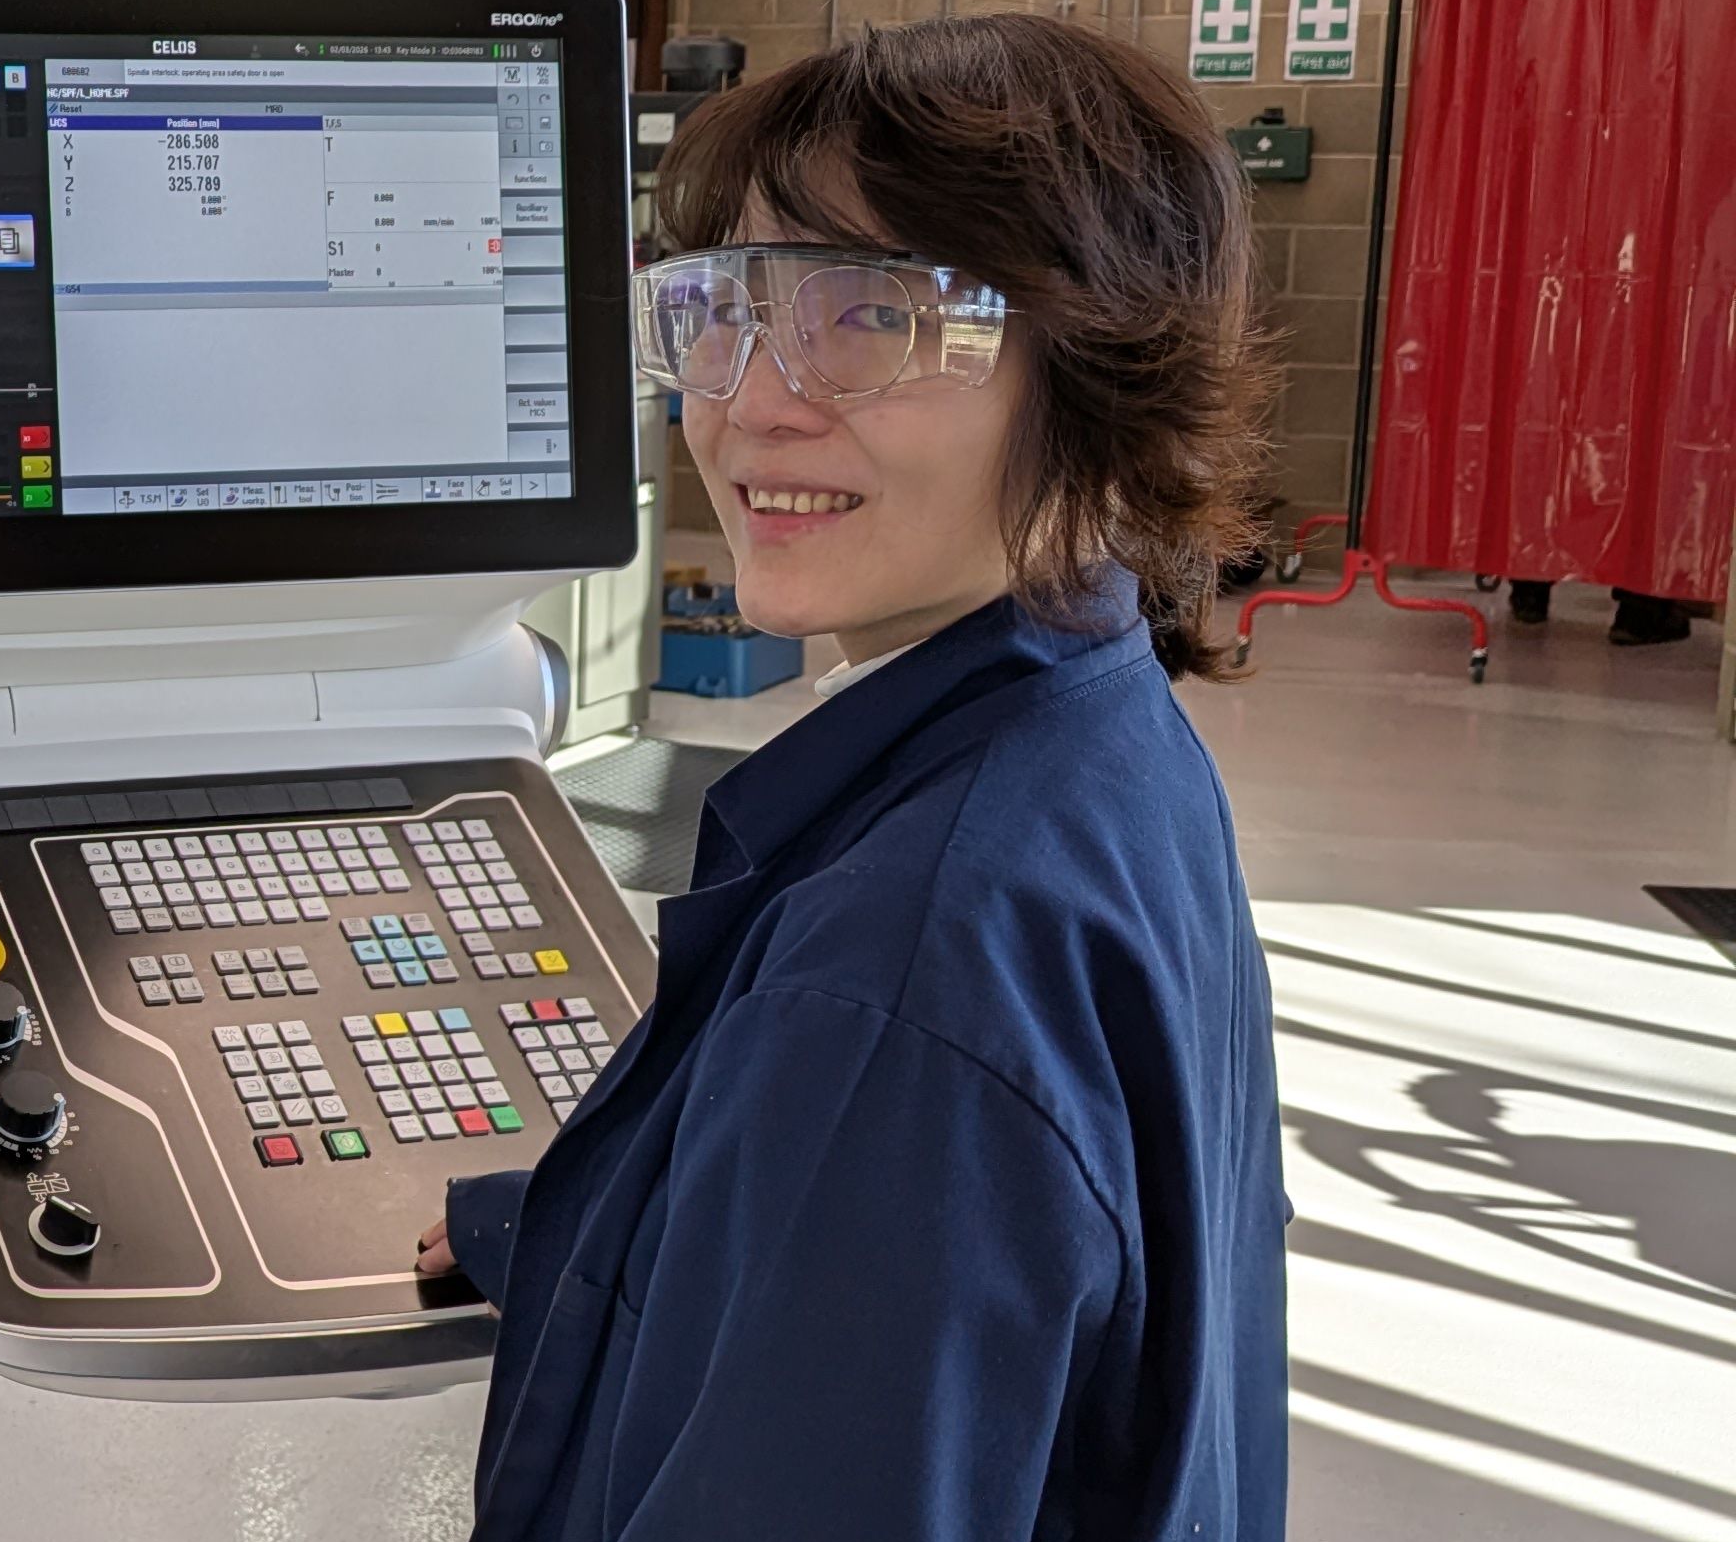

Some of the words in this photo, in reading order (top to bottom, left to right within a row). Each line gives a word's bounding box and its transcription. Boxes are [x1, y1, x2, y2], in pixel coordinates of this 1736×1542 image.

[153, 41, 196, 54] CELOS
[396, 46, 409, 55] Key
[410, 46, 430, 54] Mode
[1196, 59, 1226, 71] First
[1228, 58, 1251, 70] aid
[1292, 56, 1324, 69] First
[1327, 55, 1349, 69] aid
[128, 68, 149, 77] Spindle
[182, 69, 210, 77] operating
[227, 69, 246, 77] safety
[12, 72, 20, 84] B
[59, 104, 82, 113] Reset
[167, 118, 197, 128] Position
[199, 118, 220, 129] [mm]
[63, 134, 73, 149] X
[158, 134, 219, 149] -286.508
[325, 137, 333, 152] T
[64, 155, 73, 170] Y
[167, 155, 219, 170] 215.707
[514, 175, 547, 183] functions
[65, 177, 74, 192] Z
[168, 176, 221, 192] 325.789
[65, 196, 71, 205] C
[327, 191, 334, 206] F
[65, 208, 71, 217] B
[424, 218, 454, 226] mm/min
[516, 214, 548, 222] functions
[328, 241, 344, 256] S1
[328, 268, 354, 277] Master
[533, 399, 556, 407] values
[530, 409, 545, 417] MCS
[346, 483, 365, 491] Posi-
[447, 480, 465, 488] Face
[197, 488, 209, 496] Set
[242, 486, 264, 495] Meas.
[294, 485, 316, 493] Meas.
[298, 494, 313, 503] tool
[349, 493, 363, 501] tion
